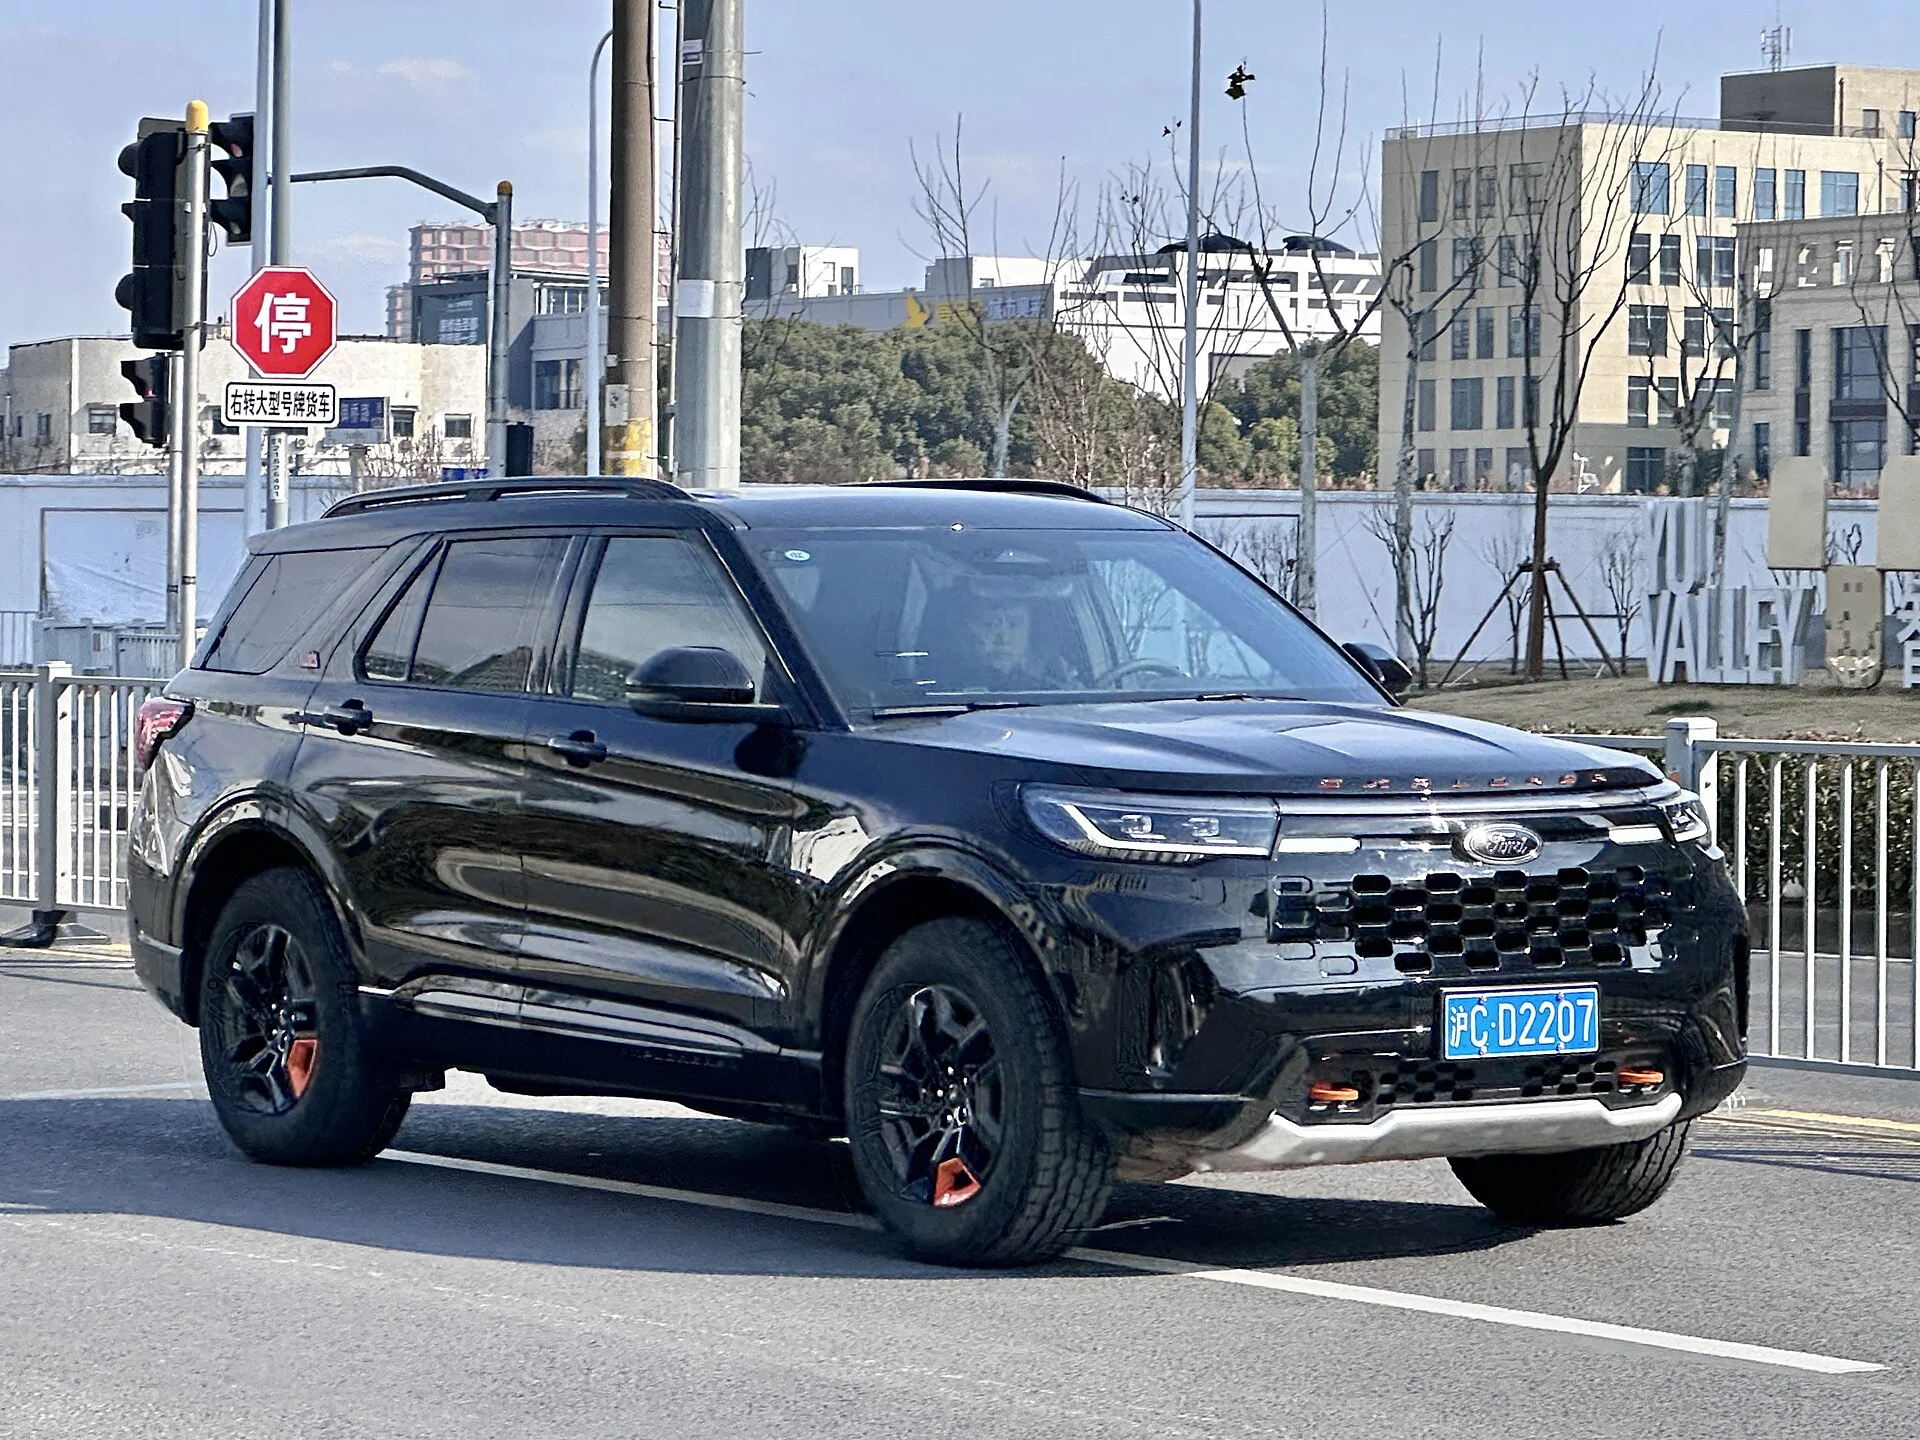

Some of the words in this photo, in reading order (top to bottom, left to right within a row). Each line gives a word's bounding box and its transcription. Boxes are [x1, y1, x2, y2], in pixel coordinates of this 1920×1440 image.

[253, 292, 311, 354] 停
[230, 389, 330, 418] 右转大型号牌货车
[1647, 587, 1816, 685] VALLEY
[1486, 831, 1528, 855] Ford
[1450, 999, 1594, 1050] 沪C·D2207
